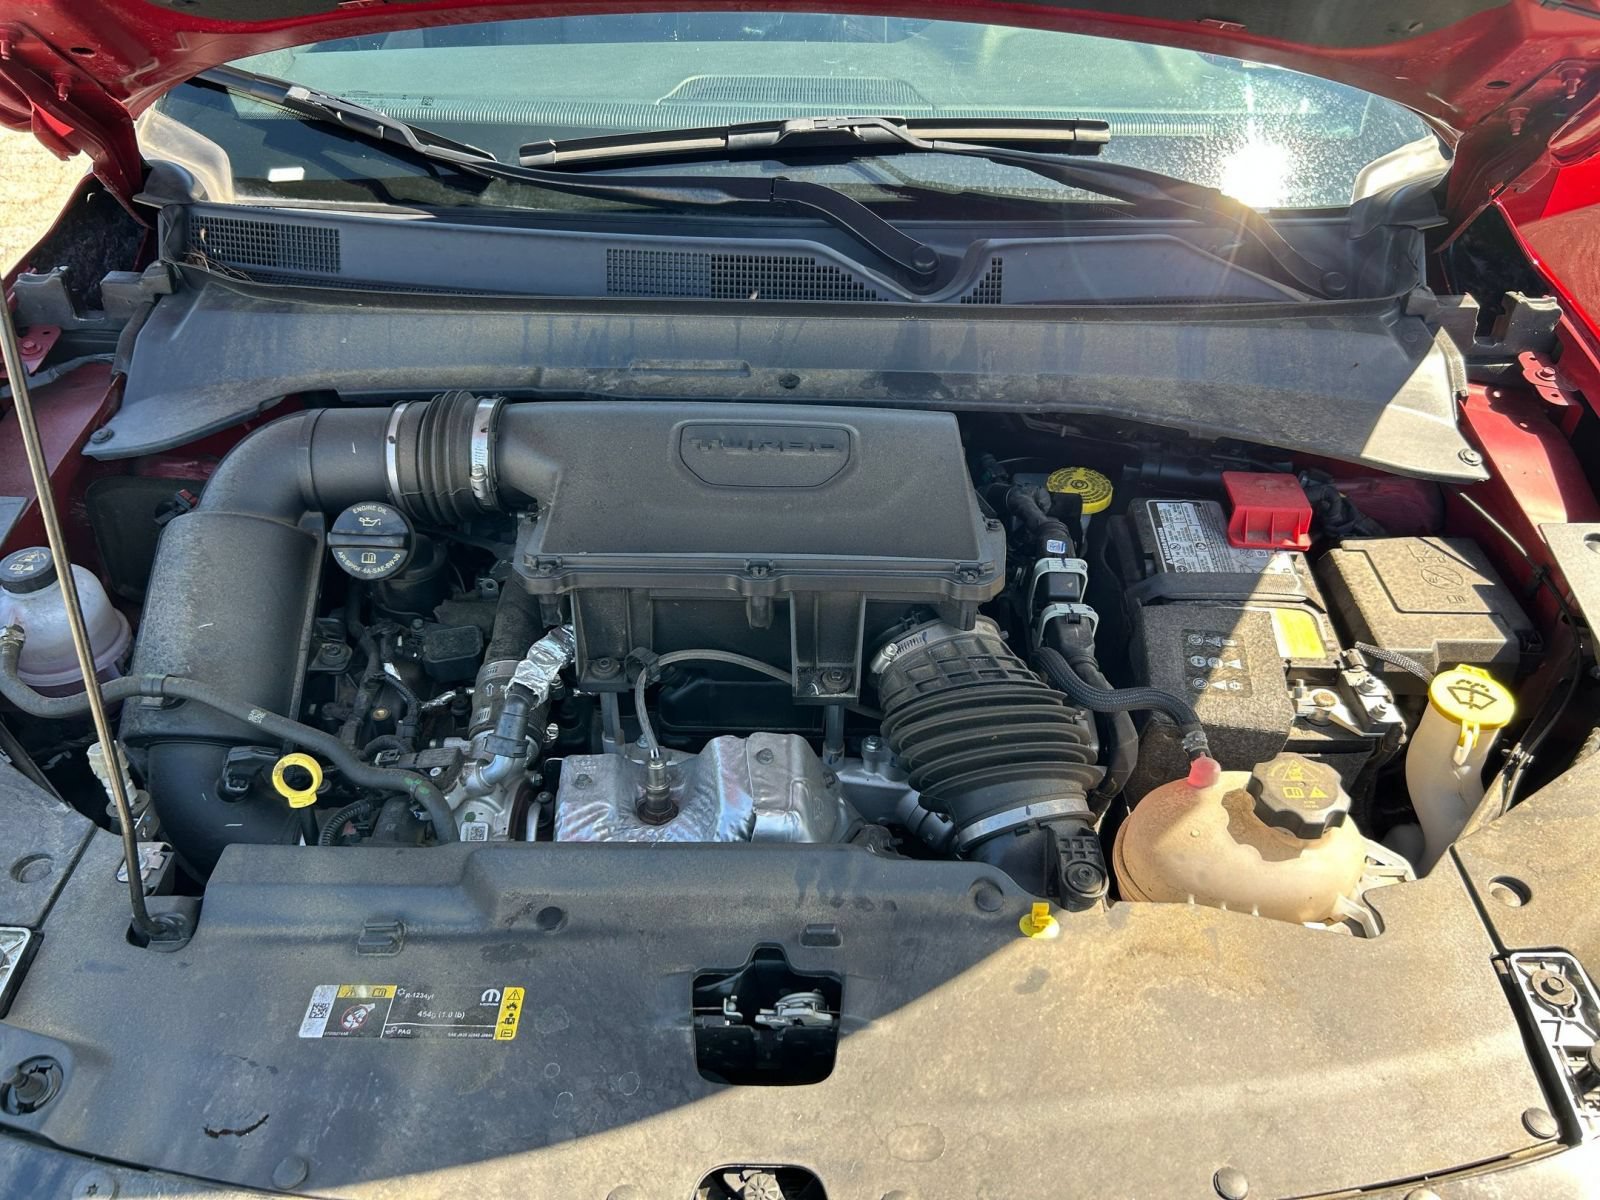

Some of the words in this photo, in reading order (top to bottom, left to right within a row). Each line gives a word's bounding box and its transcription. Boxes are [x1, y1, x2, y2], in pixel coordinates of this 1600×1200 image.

[352, 505, 377, 515] ENGINE
[377, 506, 388, 516] OIL
[404, 991, 435, 1001] R-1234yf
[397, 1028, 412, 1036] PAG
